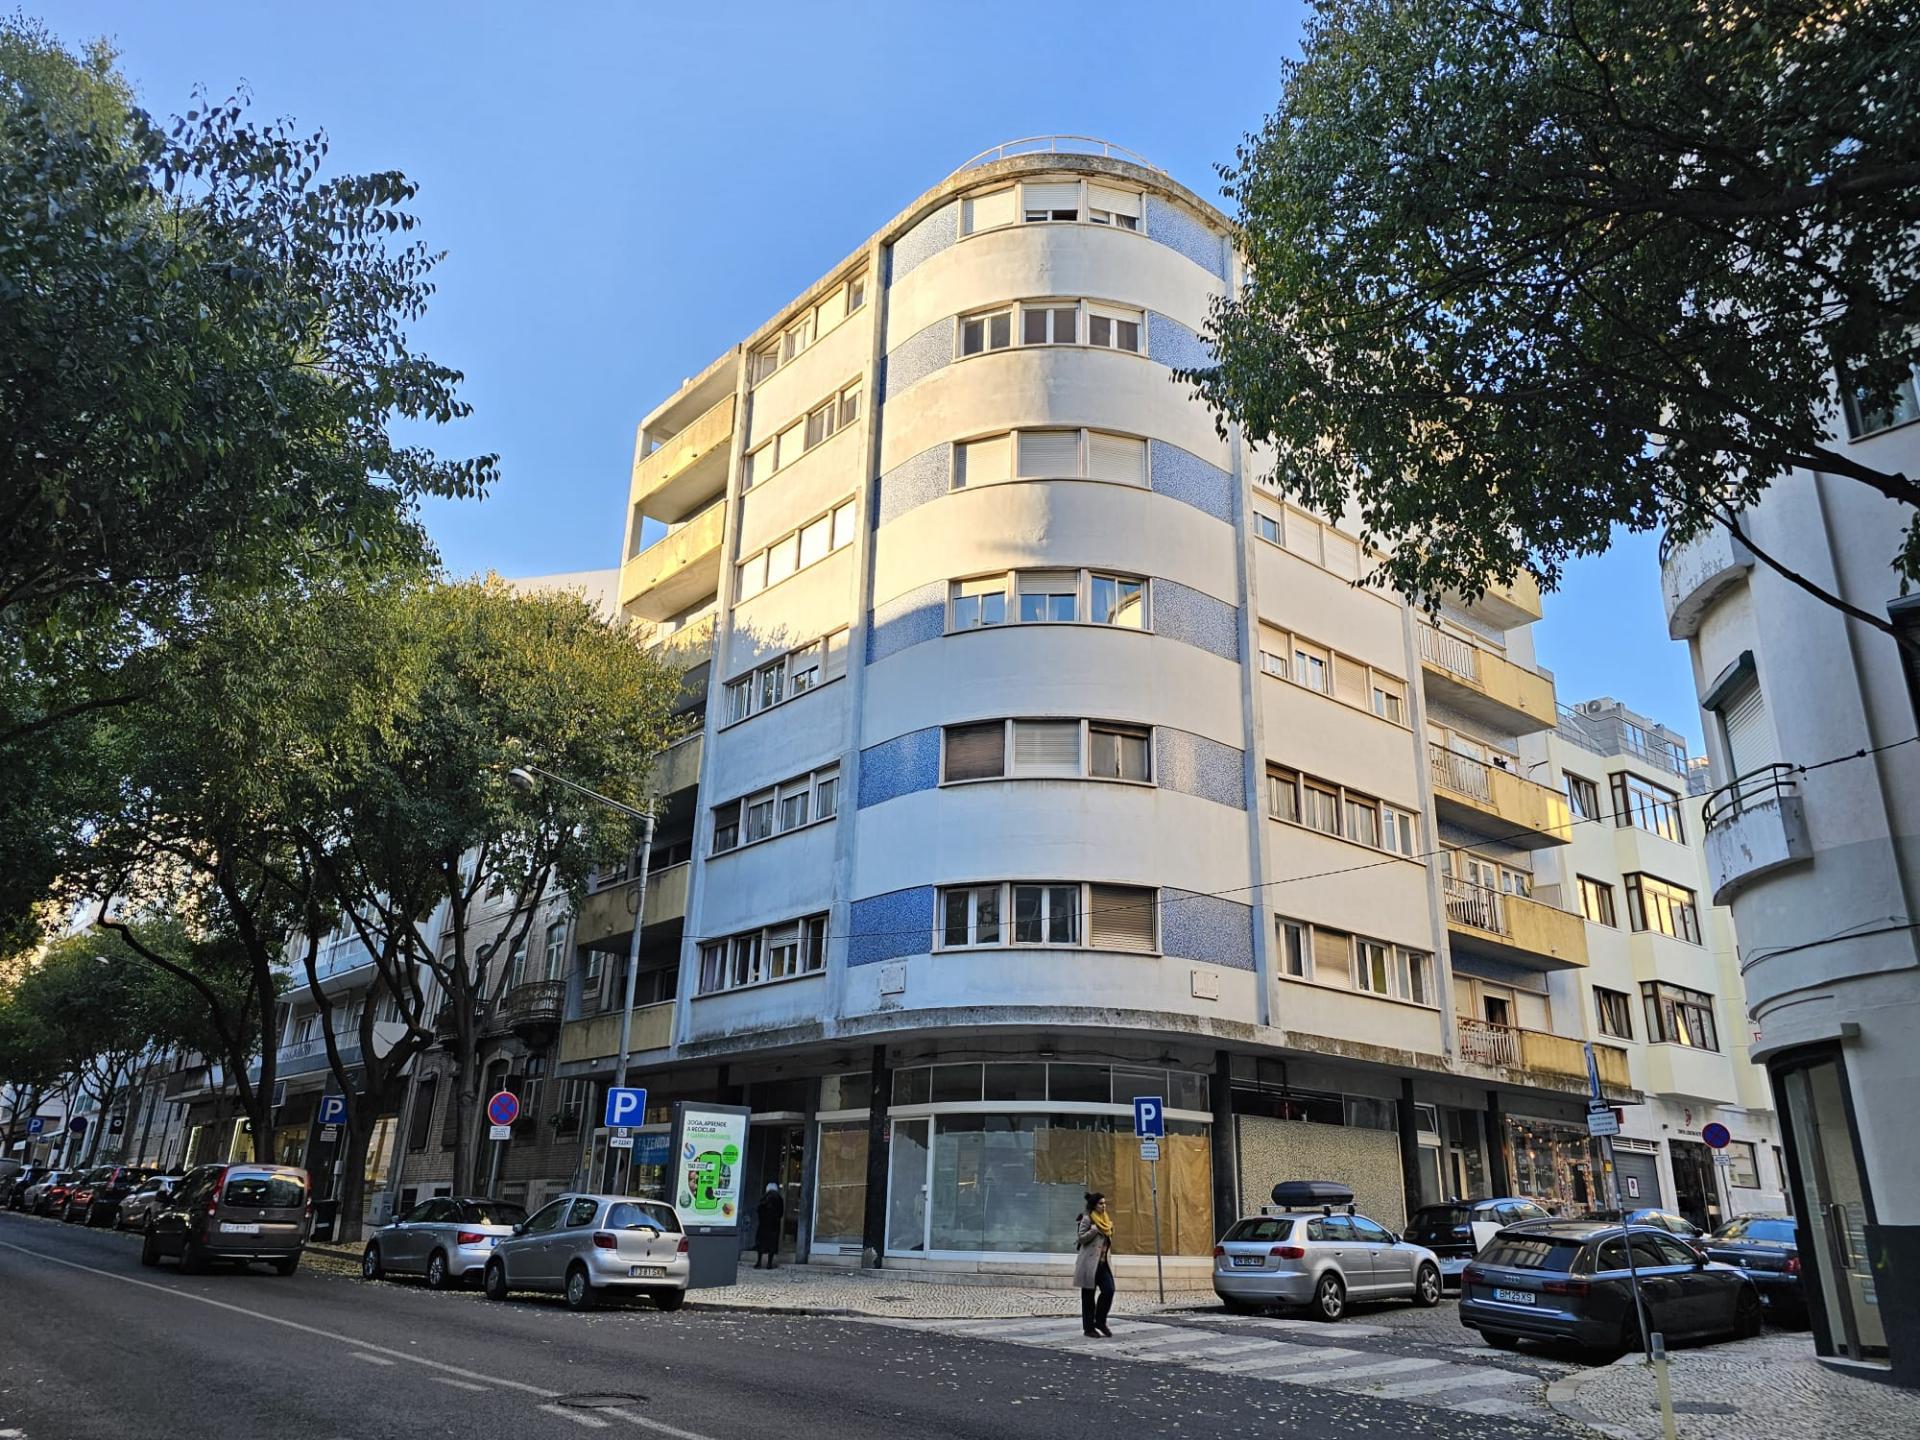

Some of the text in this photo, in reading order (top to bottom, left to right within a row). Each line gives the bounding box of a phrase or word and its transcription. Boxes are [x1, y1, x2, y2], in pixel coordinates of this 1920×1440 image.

[325, 1100, 344, 1121] P
[613, 1092, 638, 1123] P
[1141, 1103, 1156, 1132] P
[29, 1119, 41, 1132] P
